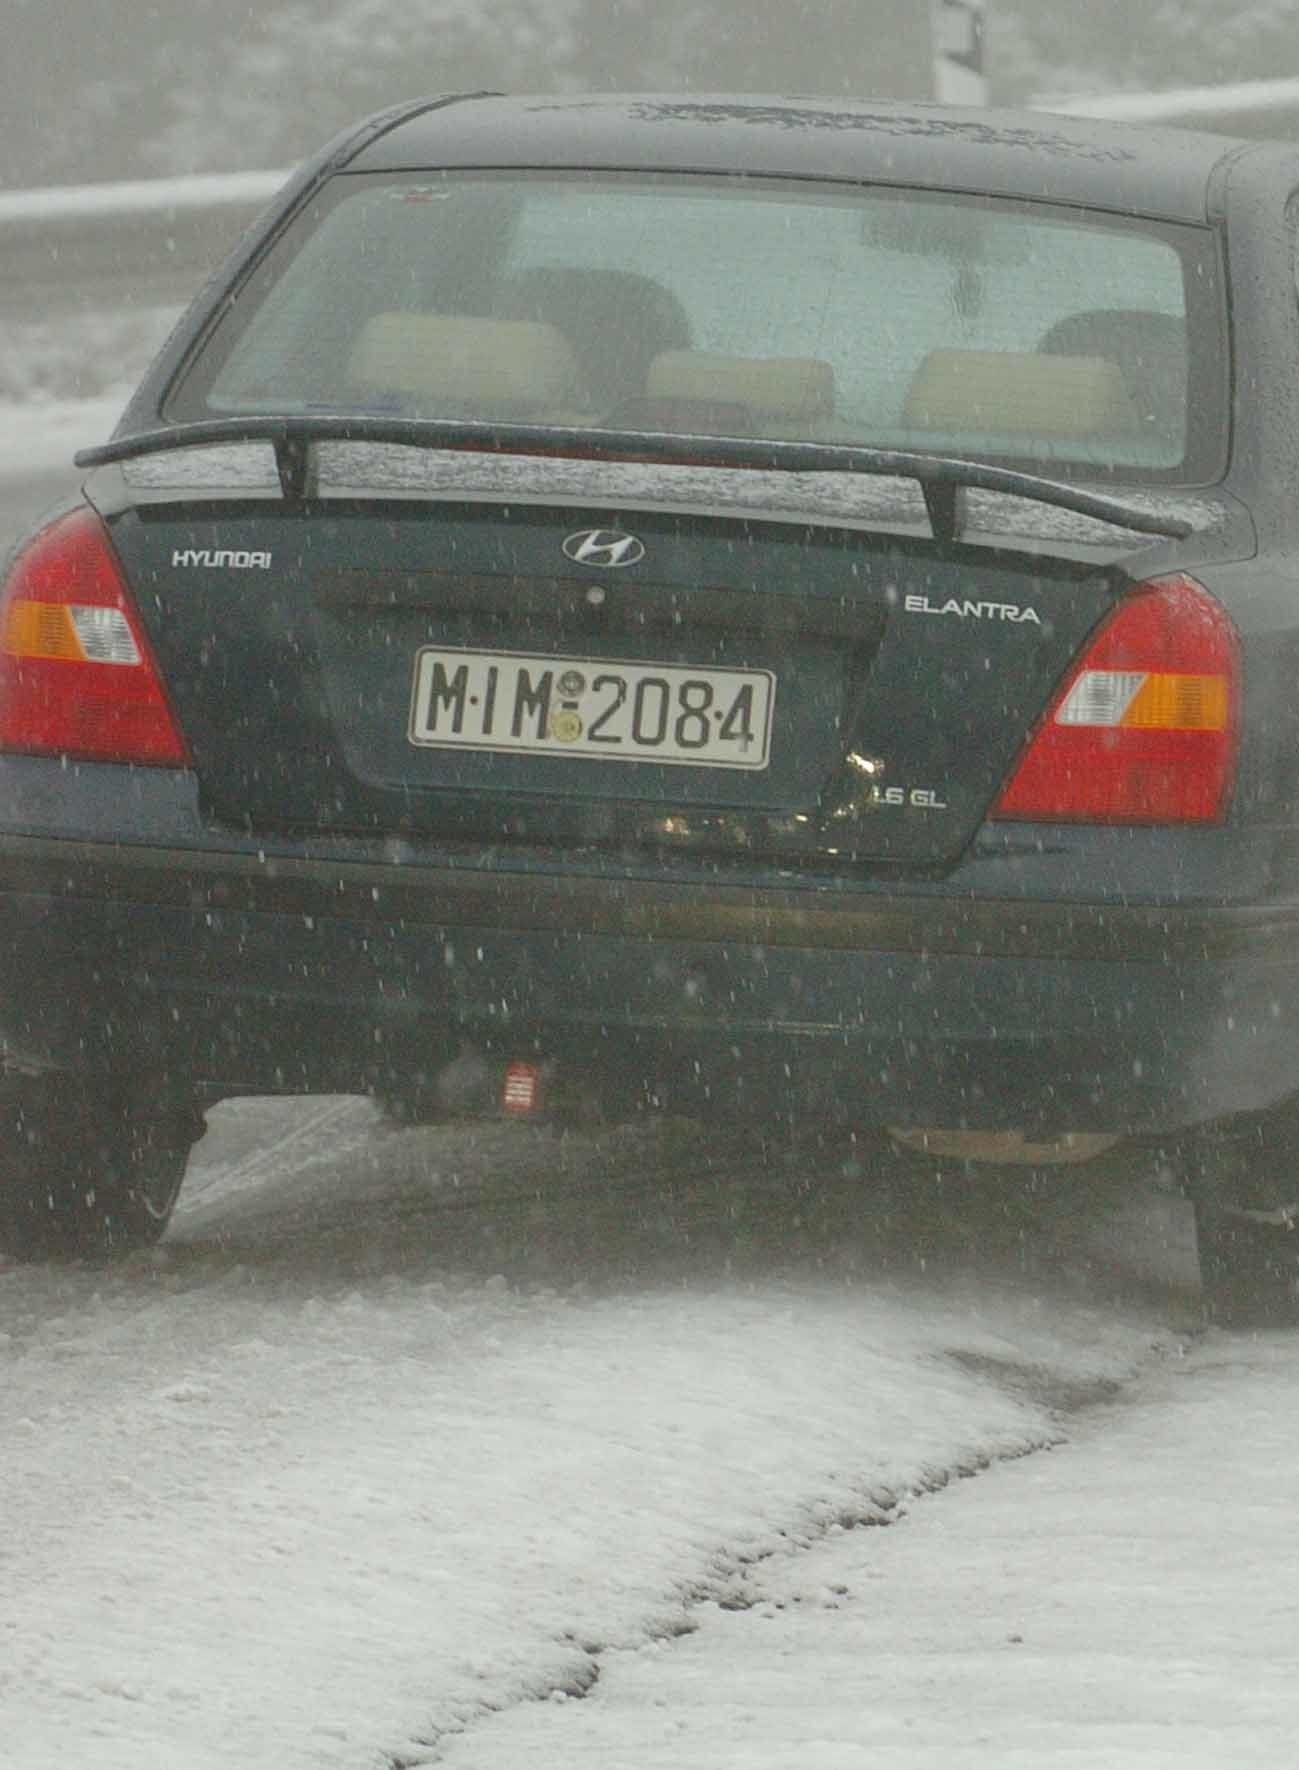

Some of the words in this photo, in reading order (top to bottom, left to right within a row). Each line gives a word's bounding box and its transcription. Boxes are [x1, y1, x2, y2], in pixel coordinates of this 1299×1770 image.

[172, 550, 272, 569] HYUNDAI
[904, 594, 1041, 624] ELANTRA
[910, 789, 947, 809] GL
